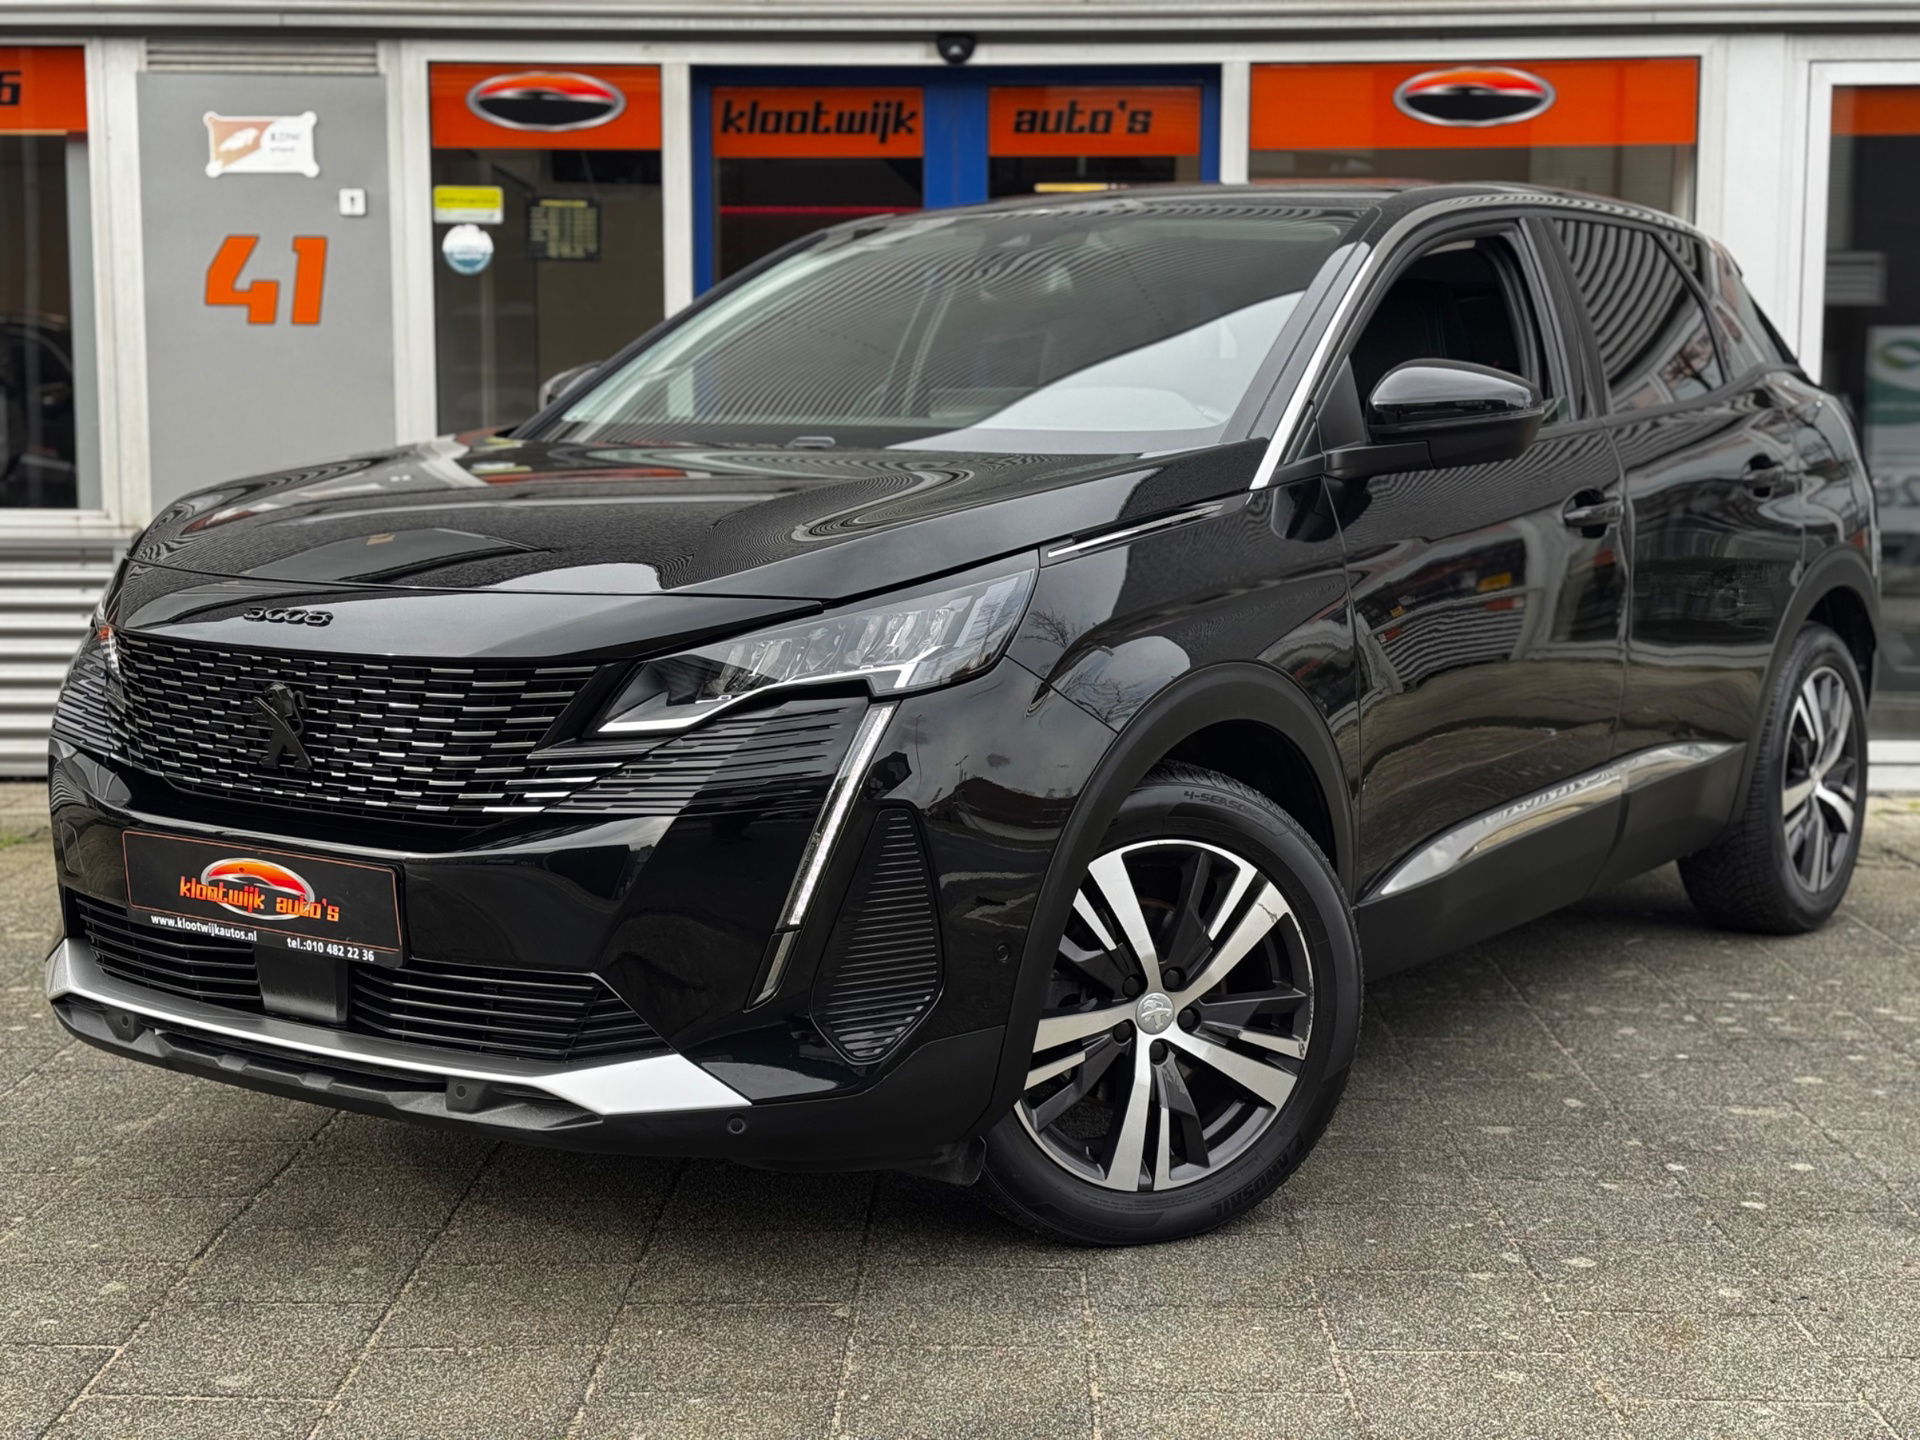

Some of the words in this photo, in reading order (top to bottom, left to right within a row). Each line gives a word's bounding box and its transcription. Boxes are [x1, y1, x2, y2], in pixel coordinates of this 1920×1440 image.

[721, 101, 916, 144] klootwijk
[1013, 100, 1152, 134] auto's
[205, 234, 328, 325] 41
[243, 607, 334, 627] 3008
[179, 876, 265, 913] klootwijk
[275, 894, 340, 922] auto's
[150, 915, 257, 941] www.klootwijkautos.nl
[286, 937, 324, 953] tel.:010
[326, 943, 345, 957] 482
[347, 948, 360, 960] 22
[361, 949, 375, 961] 36
